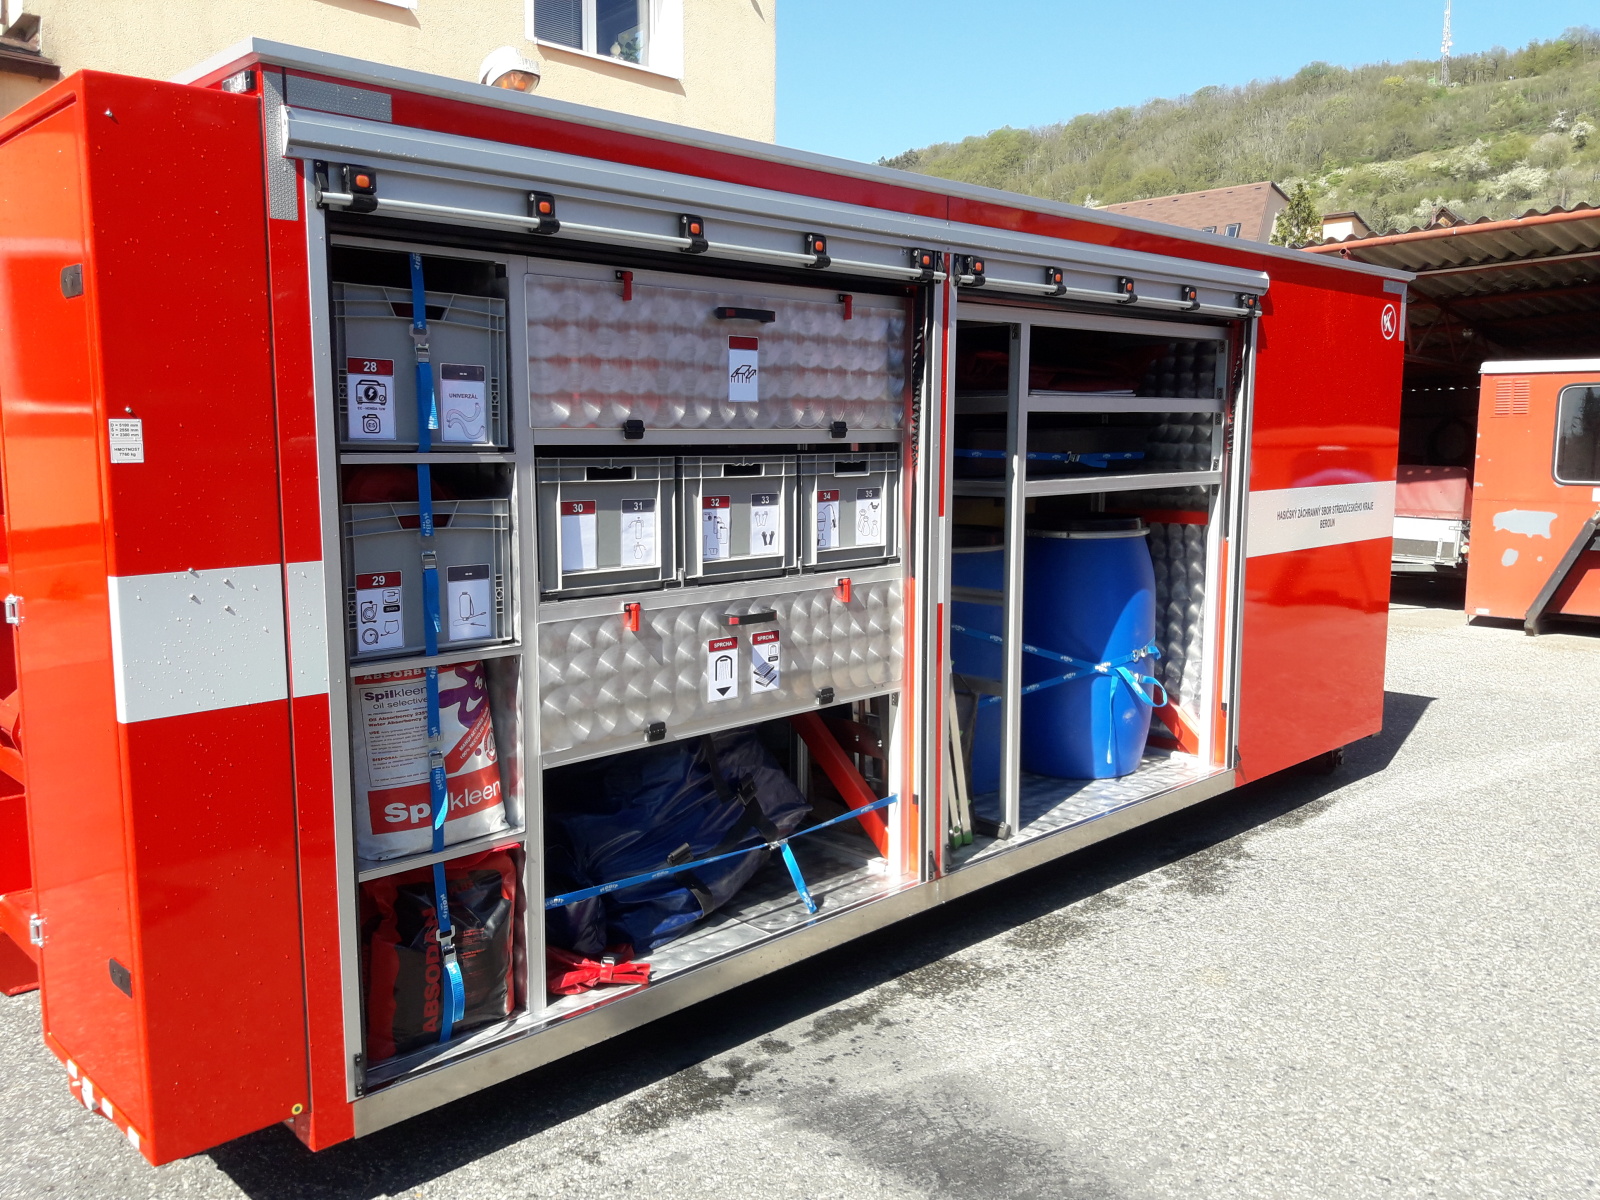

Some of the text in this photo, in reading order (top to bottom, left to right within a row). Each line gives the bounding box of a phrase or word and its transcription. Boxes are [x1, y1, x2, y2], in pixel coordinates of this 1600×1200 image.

[363, 361, 377, 372] 28
[823, 492, 831, 500] 34
[865, 490, 873, 498] 35
[710, 498, 720, 507] 32
[761, 496, 769, 504] 33
[573, 504, 583, 512] 30
[633, 502, 643, 511] 31
[1321, 506, 1332, 516] SBOR
[1363, 501, 1374, 511] KRAJE
[1320, 518, 1336, 529] BEROUN
[372, 575, 385, 586] 29
[384, 781, 500, 824] Spkleen
